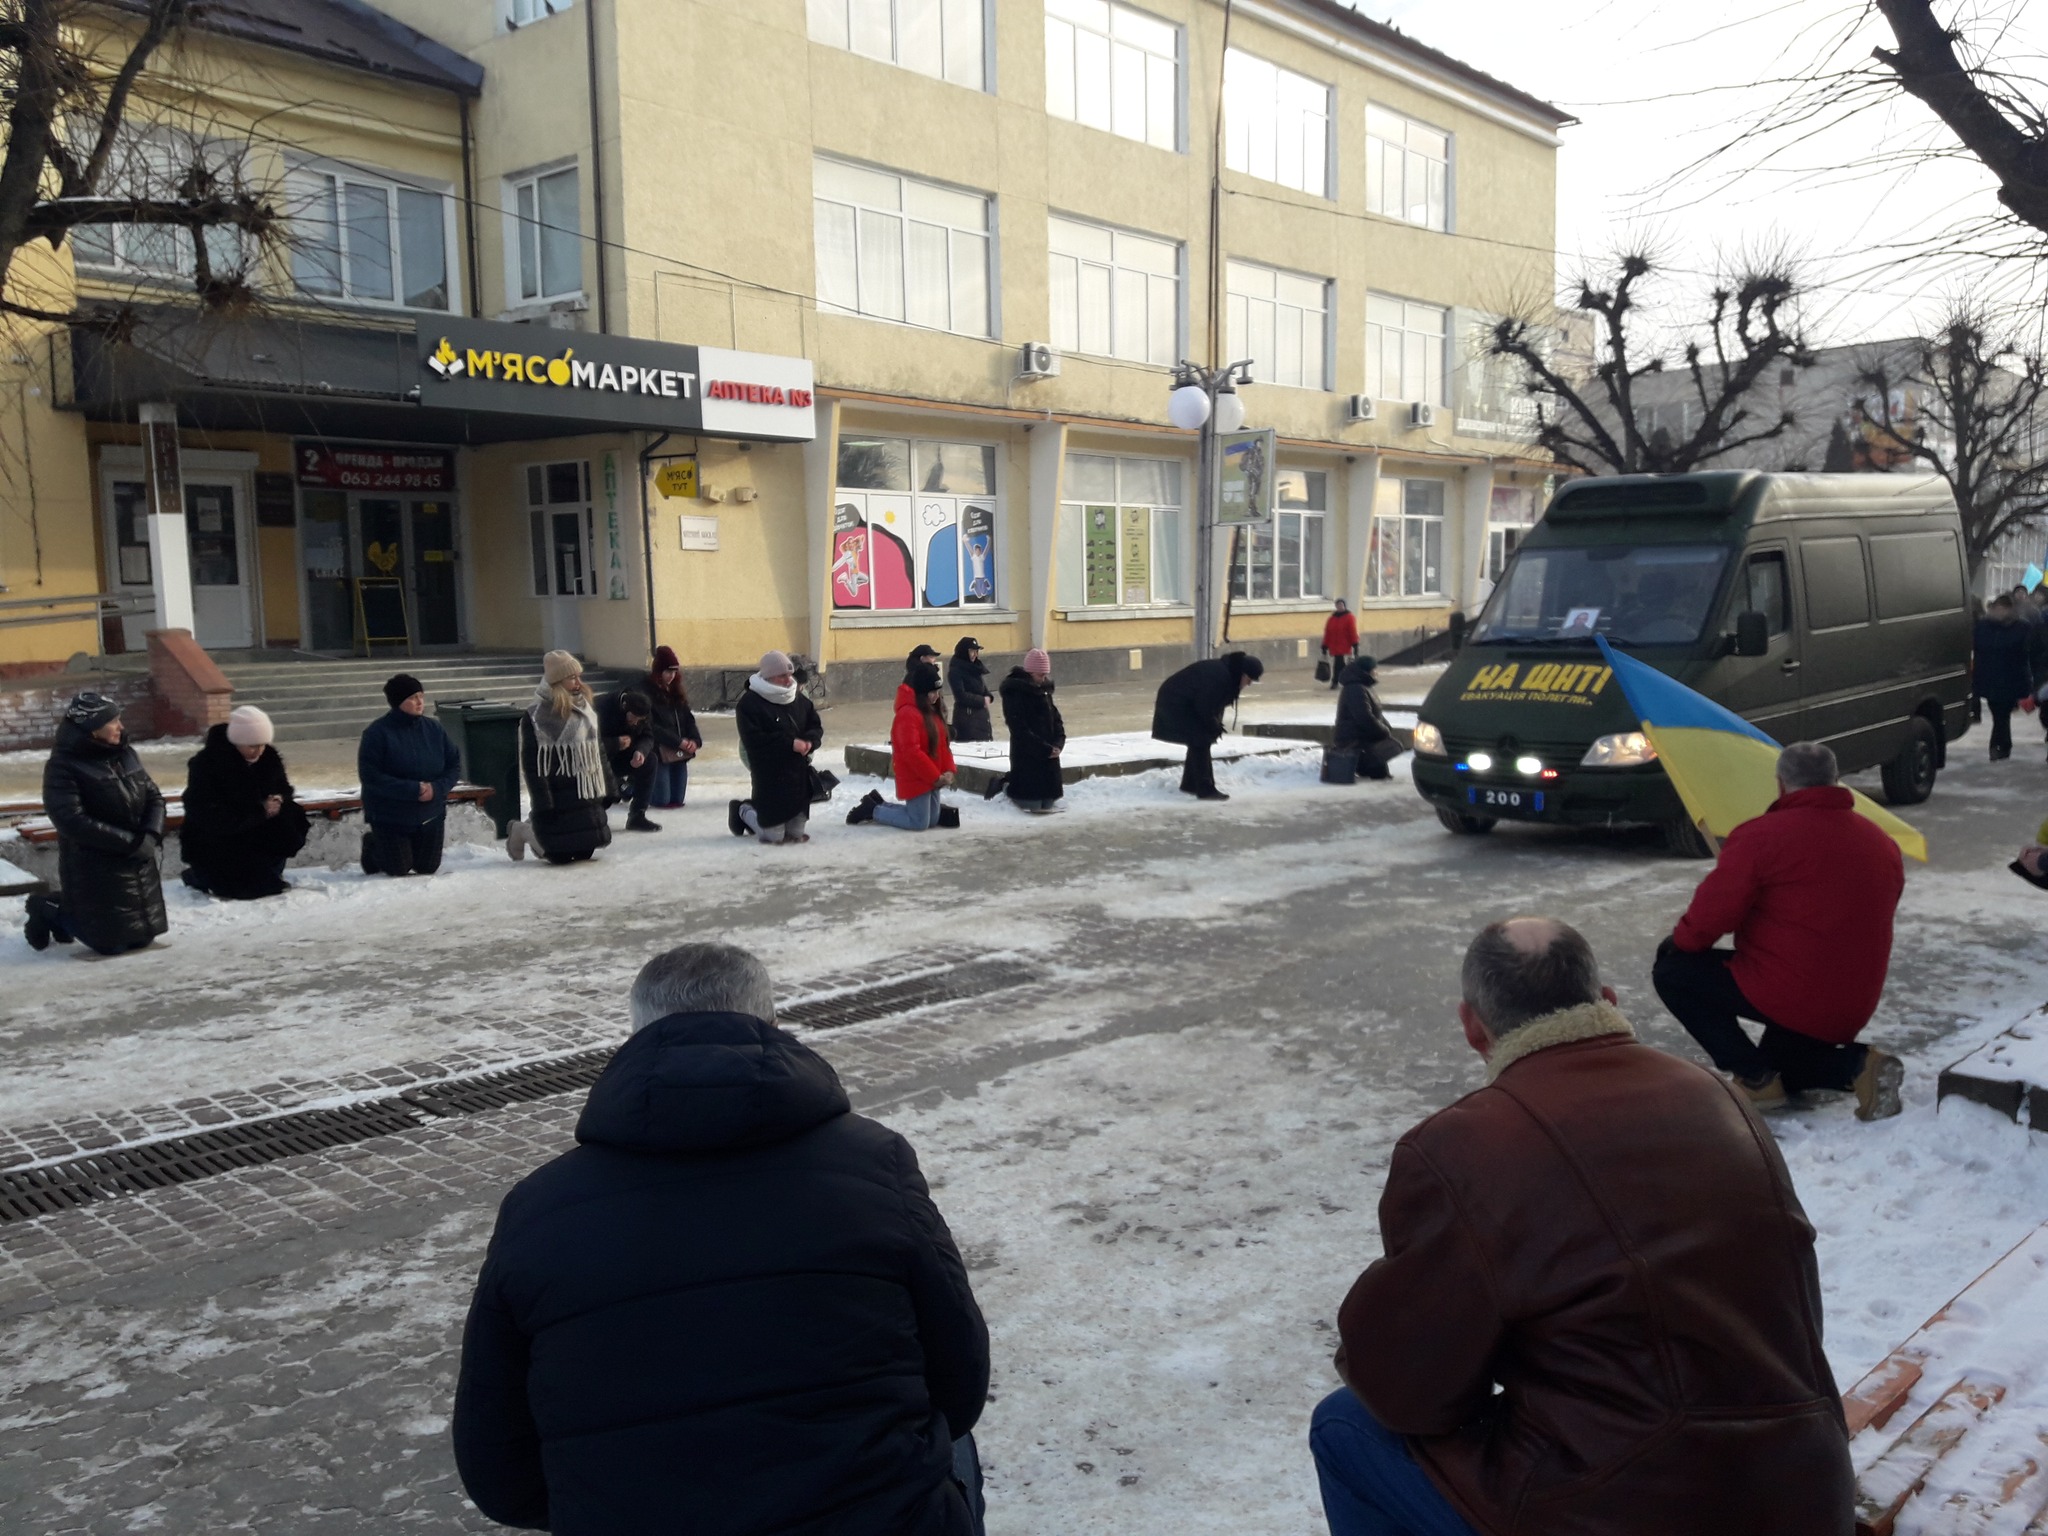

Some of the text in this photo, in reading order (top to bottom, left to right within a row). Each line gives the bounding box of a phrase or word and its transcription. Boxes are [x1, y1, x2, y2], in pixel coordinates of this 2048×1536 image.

[708, 379, 785, 405] АПТЕКА
[340, 471, 370, 486] 063
[373, 473, 401, 487] 244
[404, 473, 422, 487] 98
[423, 474, 442, 488] 45
[672, 482, 688, 491] ТУТ
[603, 452, 622, 570] АПТЕКА
[1467, 662, 1614, 695] НА ЩИТІ
[1460, 690, 1527, 702] ЕВАКУАЦІЯ
[1485, 790, 1521, 807] 200
